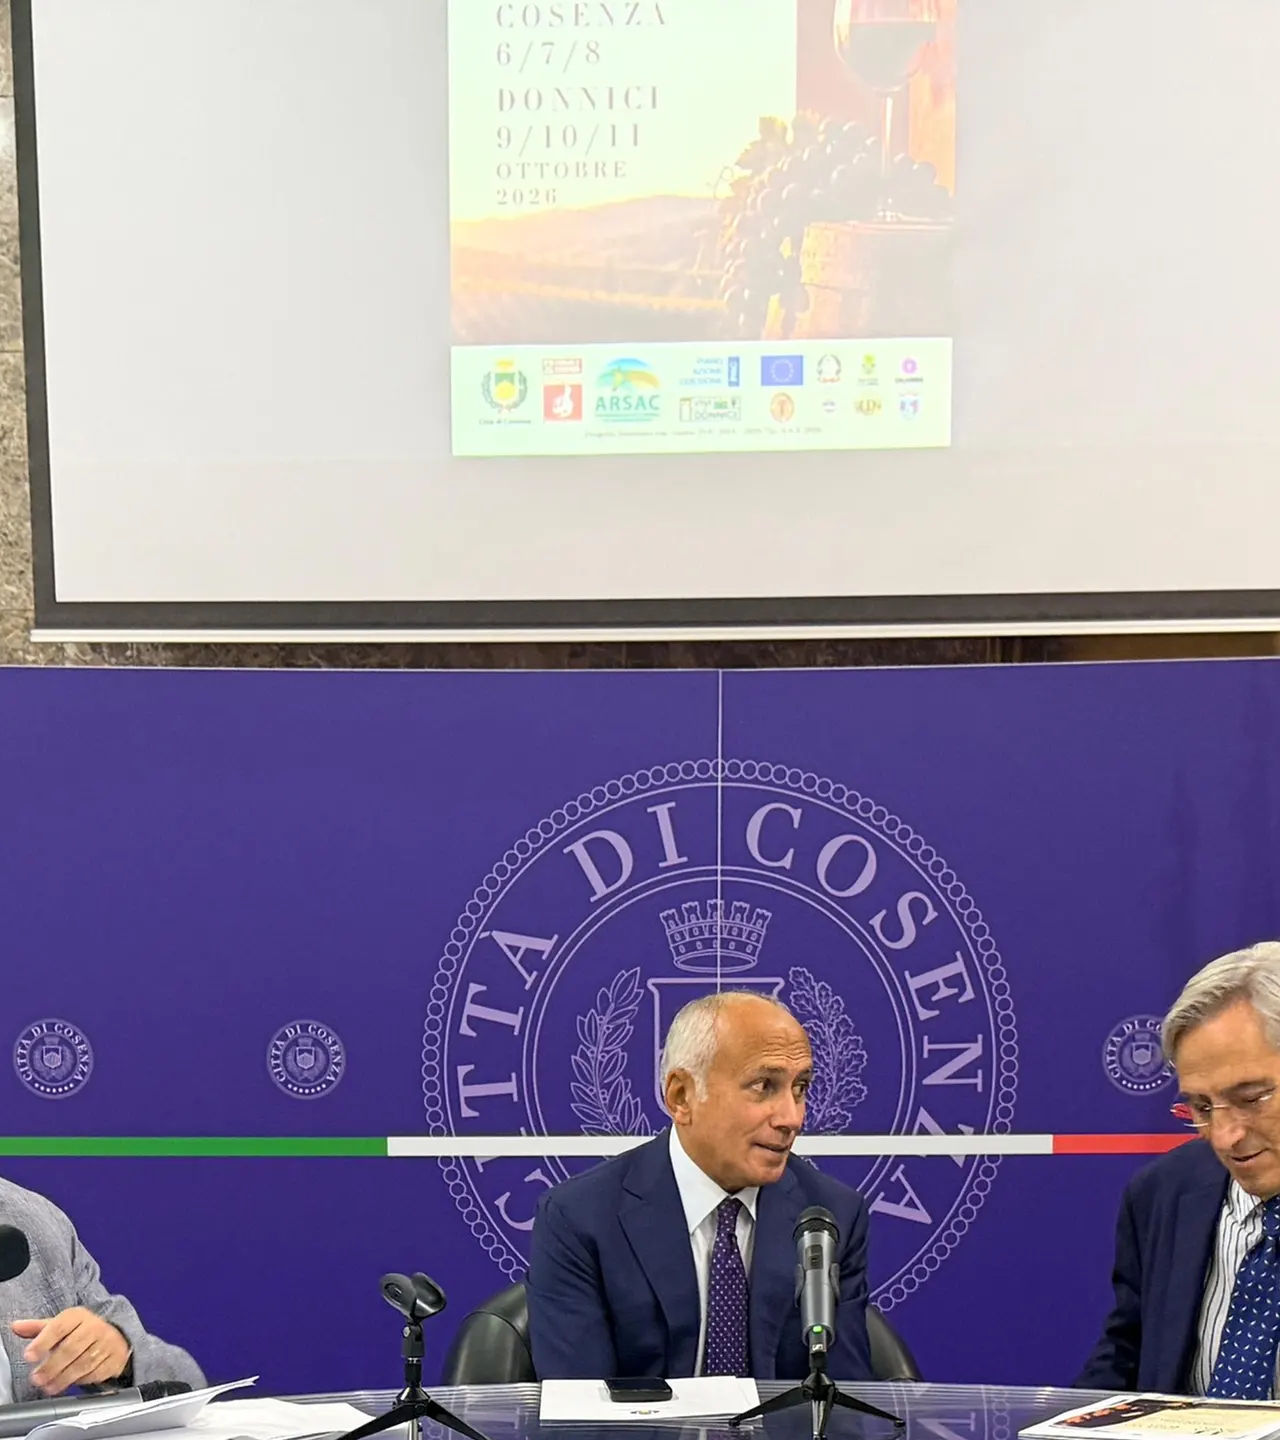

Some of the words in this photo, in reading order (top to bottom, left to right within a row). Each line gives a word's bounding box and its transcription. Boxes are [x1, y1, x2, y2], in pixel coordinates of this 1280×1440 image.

[496, 2, 666, 29] COSENZA
[496, 40, 601, 73] 6/7/8
[497, 85, 659, 112] DONNICI
[496, 123, 640, 157] 9/10/11
[496, 161, 628, 180] OTTOBRE
[496, 187, 557, 205] 2026
[595, 394, 660, 412] ARSAC
[563, 802, 689, 902] DI
[746, 802, 983, 1225] COSENZA
[1122, 1019, 1139, 1034] DI
[31, 1023, 48, 1037] DI
[54, 1022, 90, 1081] COSENZA
[285, 1024, 301, 1038] DI
[308, 1023, 342, 1082] COSENZA
